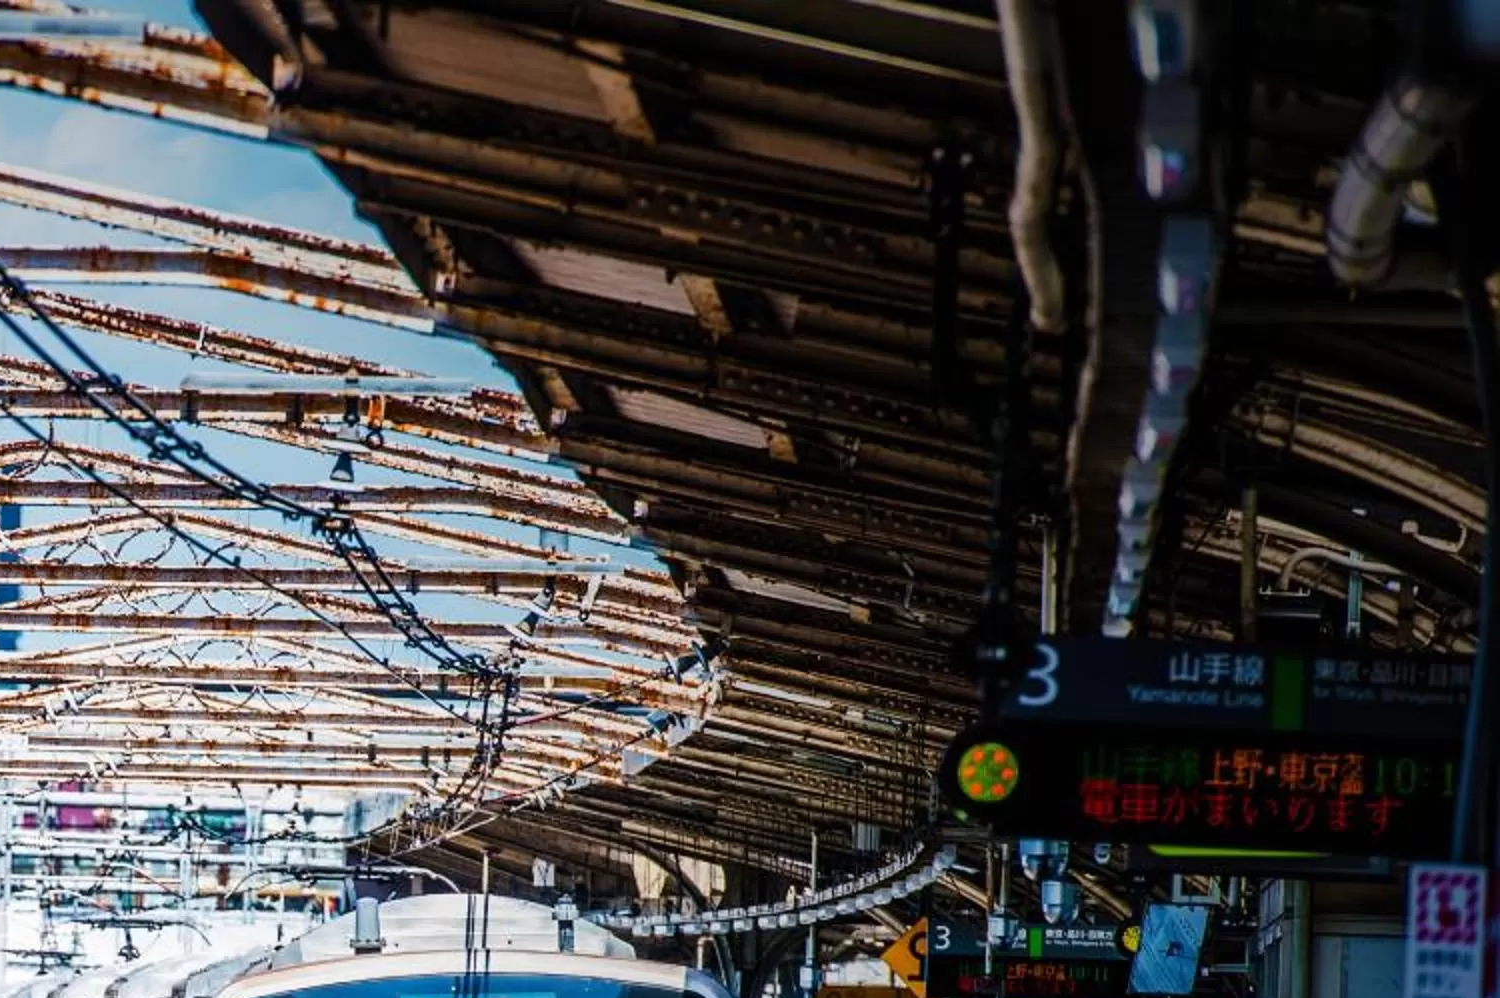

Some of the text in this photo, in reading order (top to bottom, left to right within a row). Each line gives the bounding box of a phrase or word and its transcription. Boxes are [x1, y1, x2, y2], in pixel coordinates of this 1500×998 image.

[1018, 643, 1060, 706] 3
[1168, 651, 1265, 685] 山手線
[1080, 779, 1406, 838] 電車がまいります
[934, 925, 951, 950] 3
